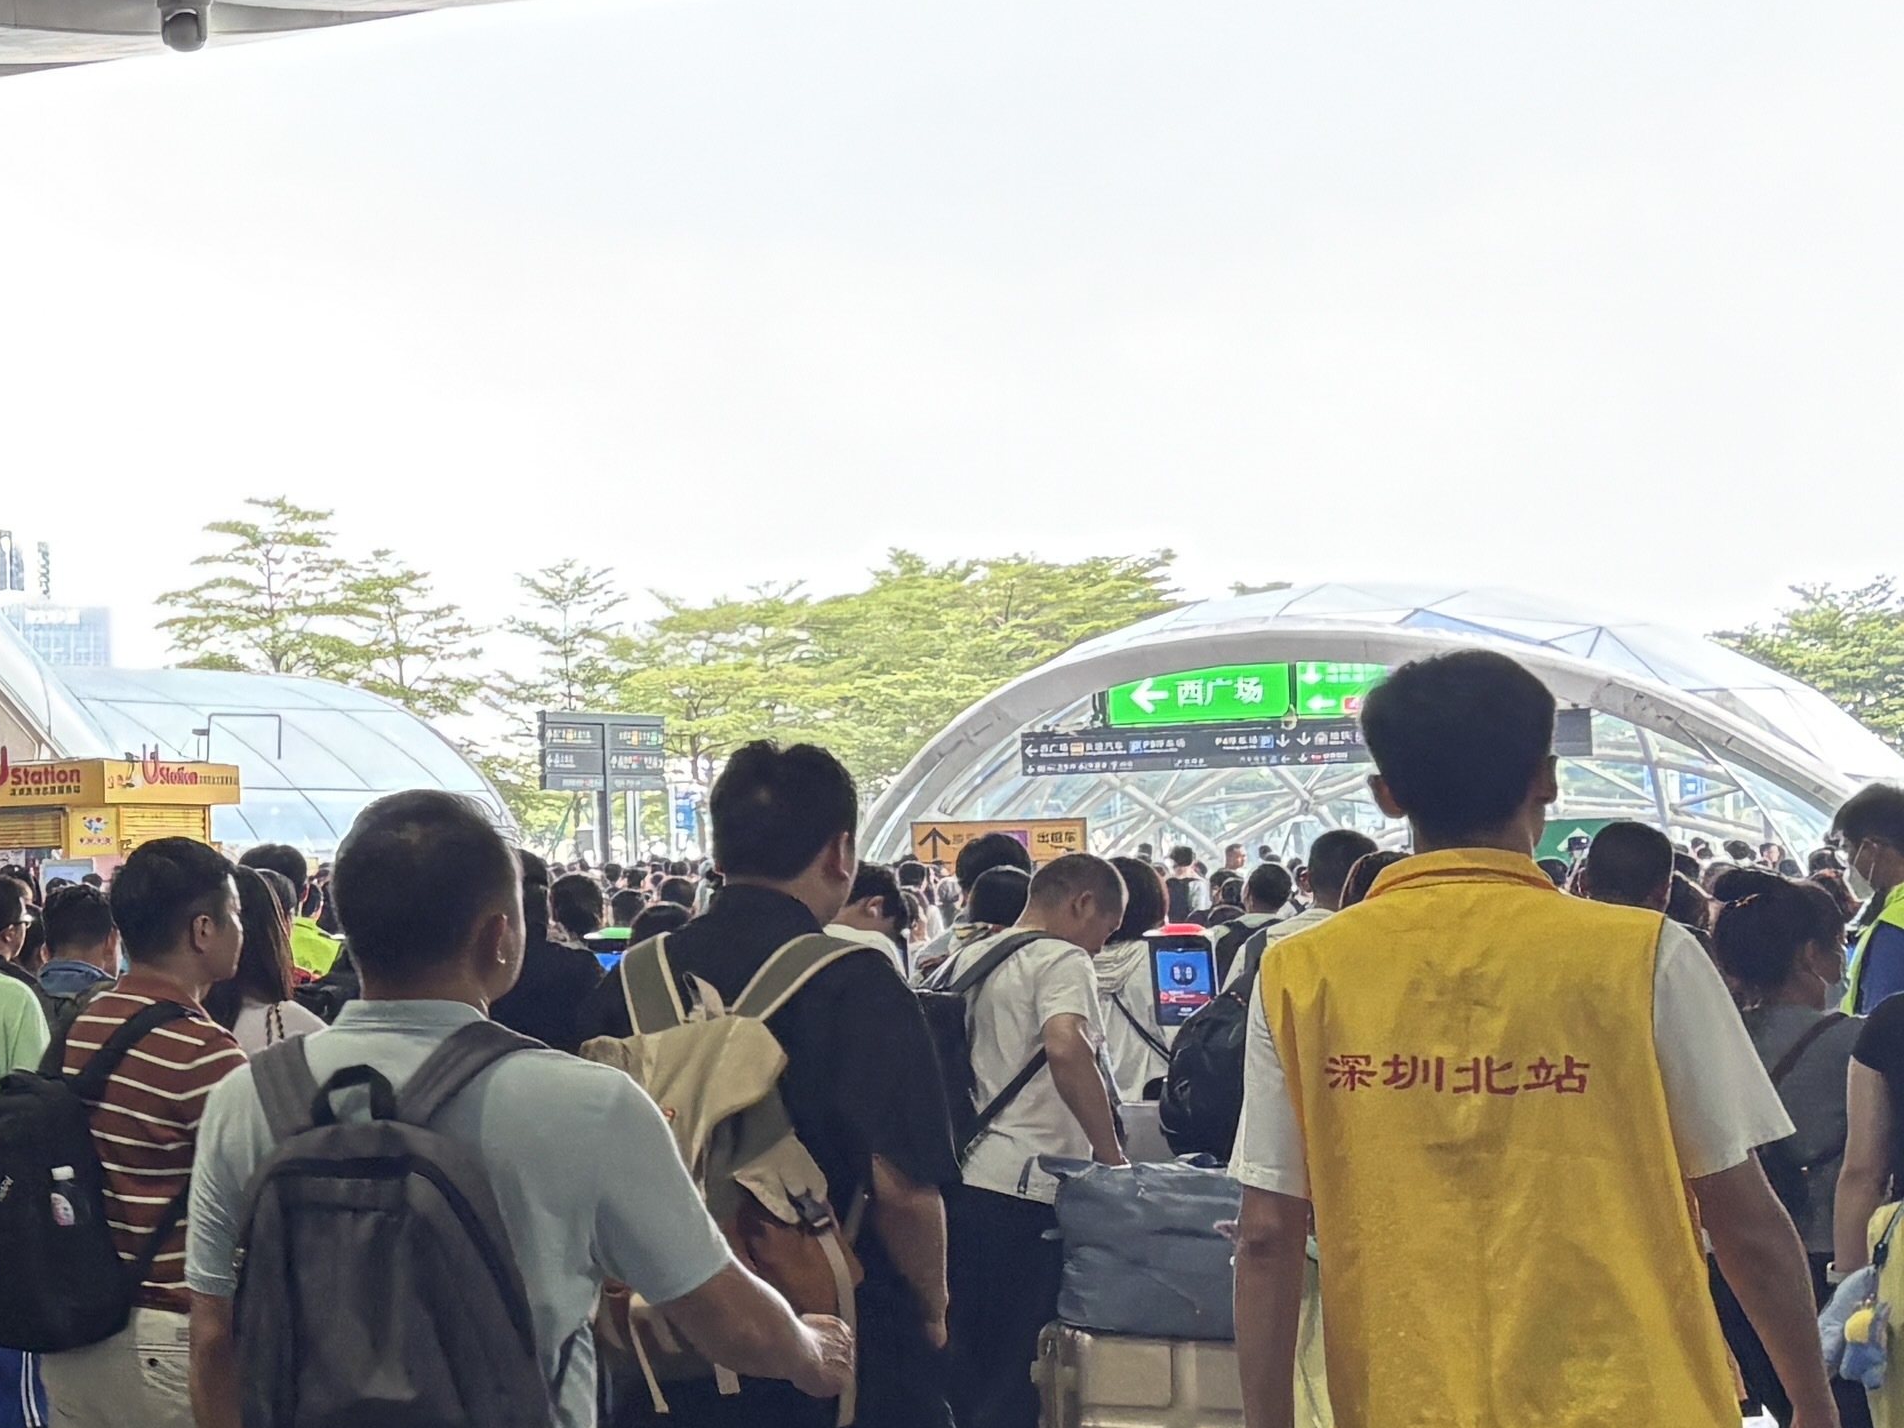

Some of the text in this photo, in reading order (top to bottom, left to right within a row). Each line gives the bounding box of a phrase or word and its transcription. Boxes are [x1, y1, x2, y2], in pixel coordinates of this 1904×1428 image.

[1174, 676, 1264, 707] 西广场
[10, 764, 81, 785] Station
[142, 743, 160, 784] U
[1325, 1054, 1590, 1095] 深圳北站
